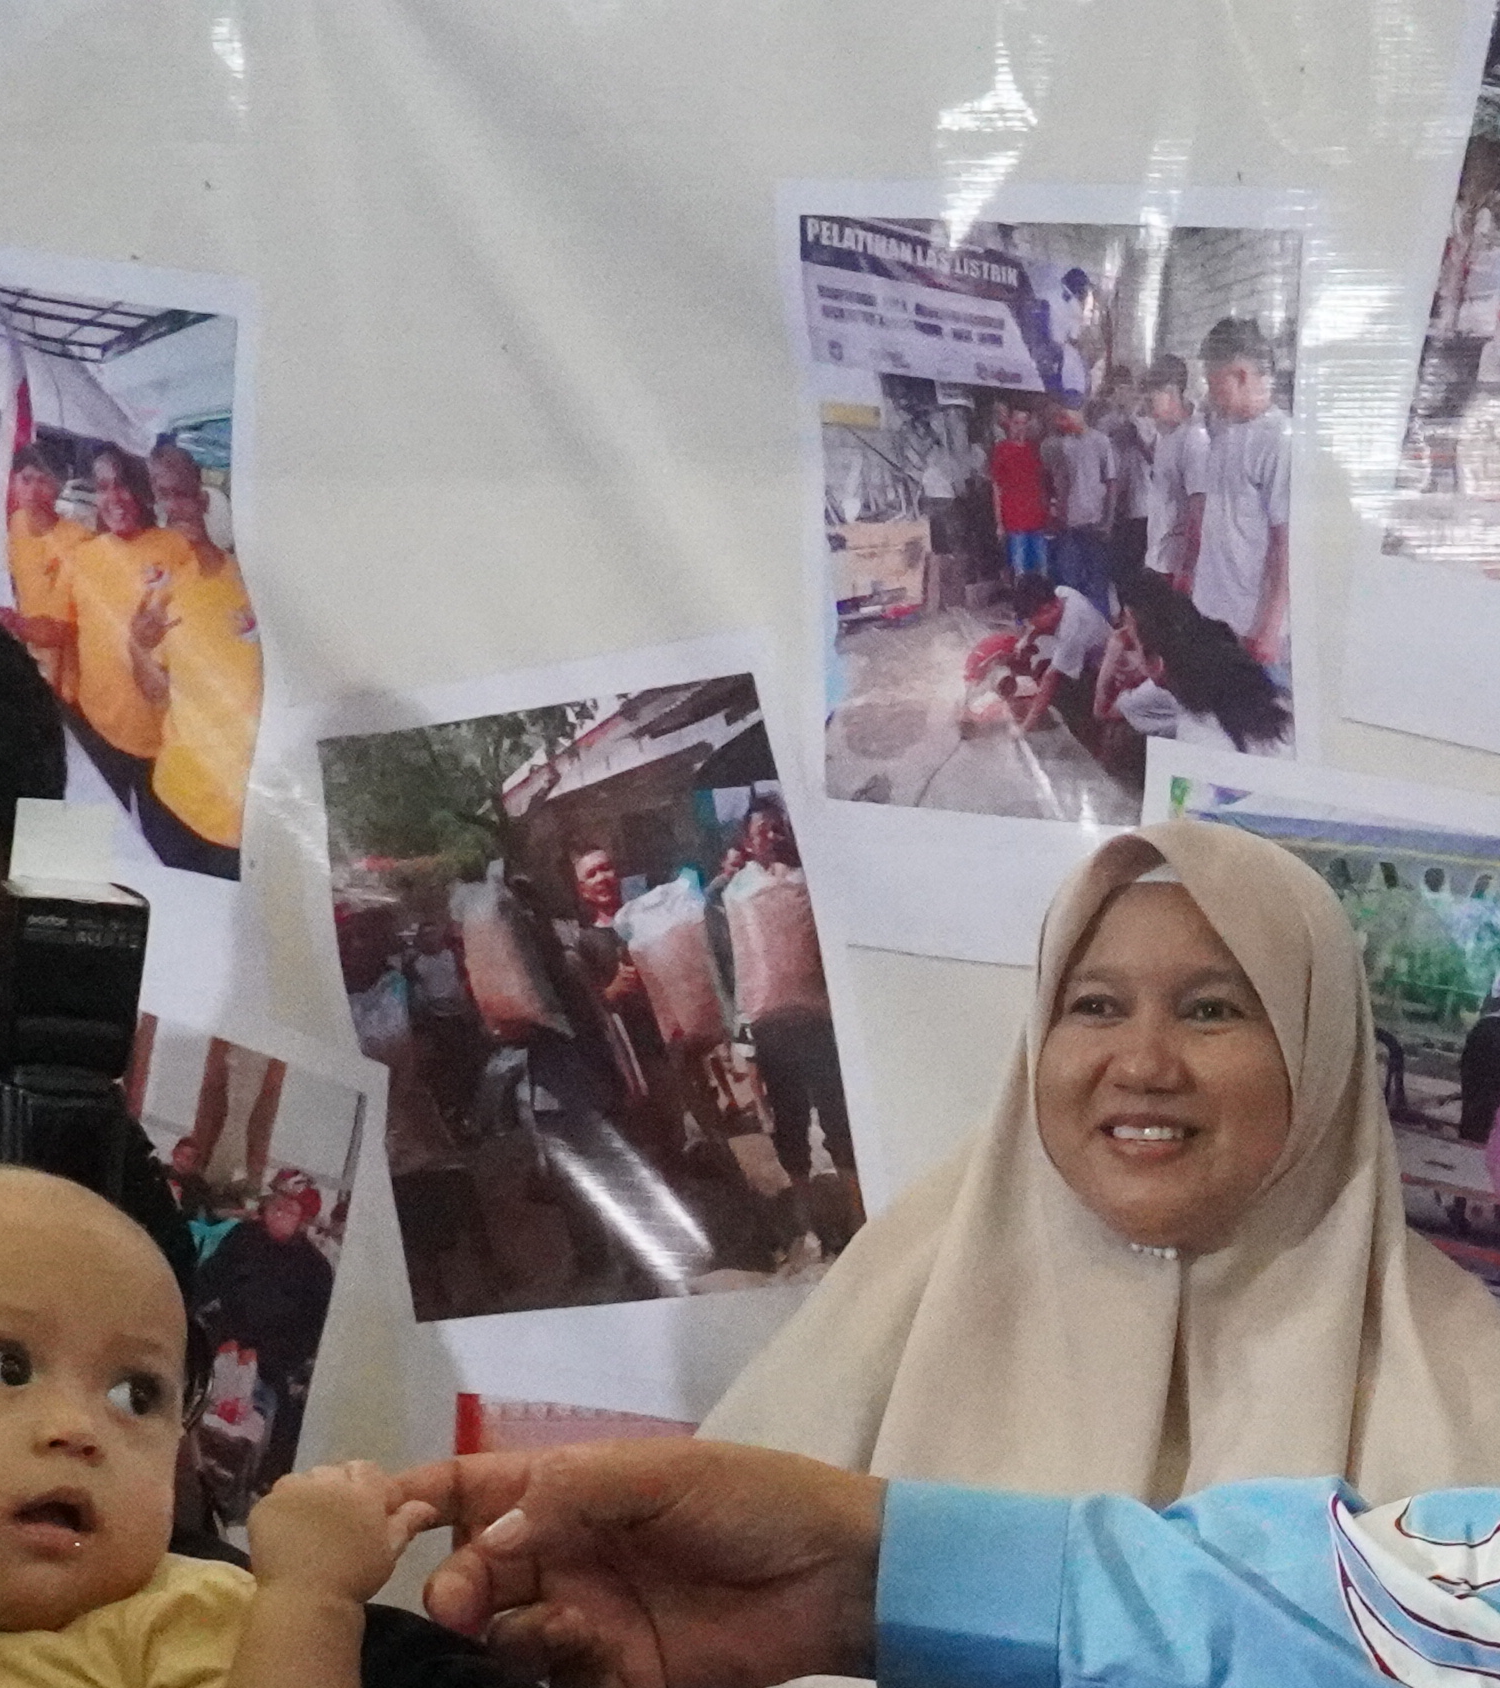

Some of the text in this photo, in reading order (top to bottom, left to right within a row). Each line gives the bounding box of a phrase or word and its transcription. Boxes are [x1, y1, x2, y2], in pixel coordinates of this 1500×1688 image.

[806, 217, 1020, 288] PELATIHAN LAS LISTRIK
